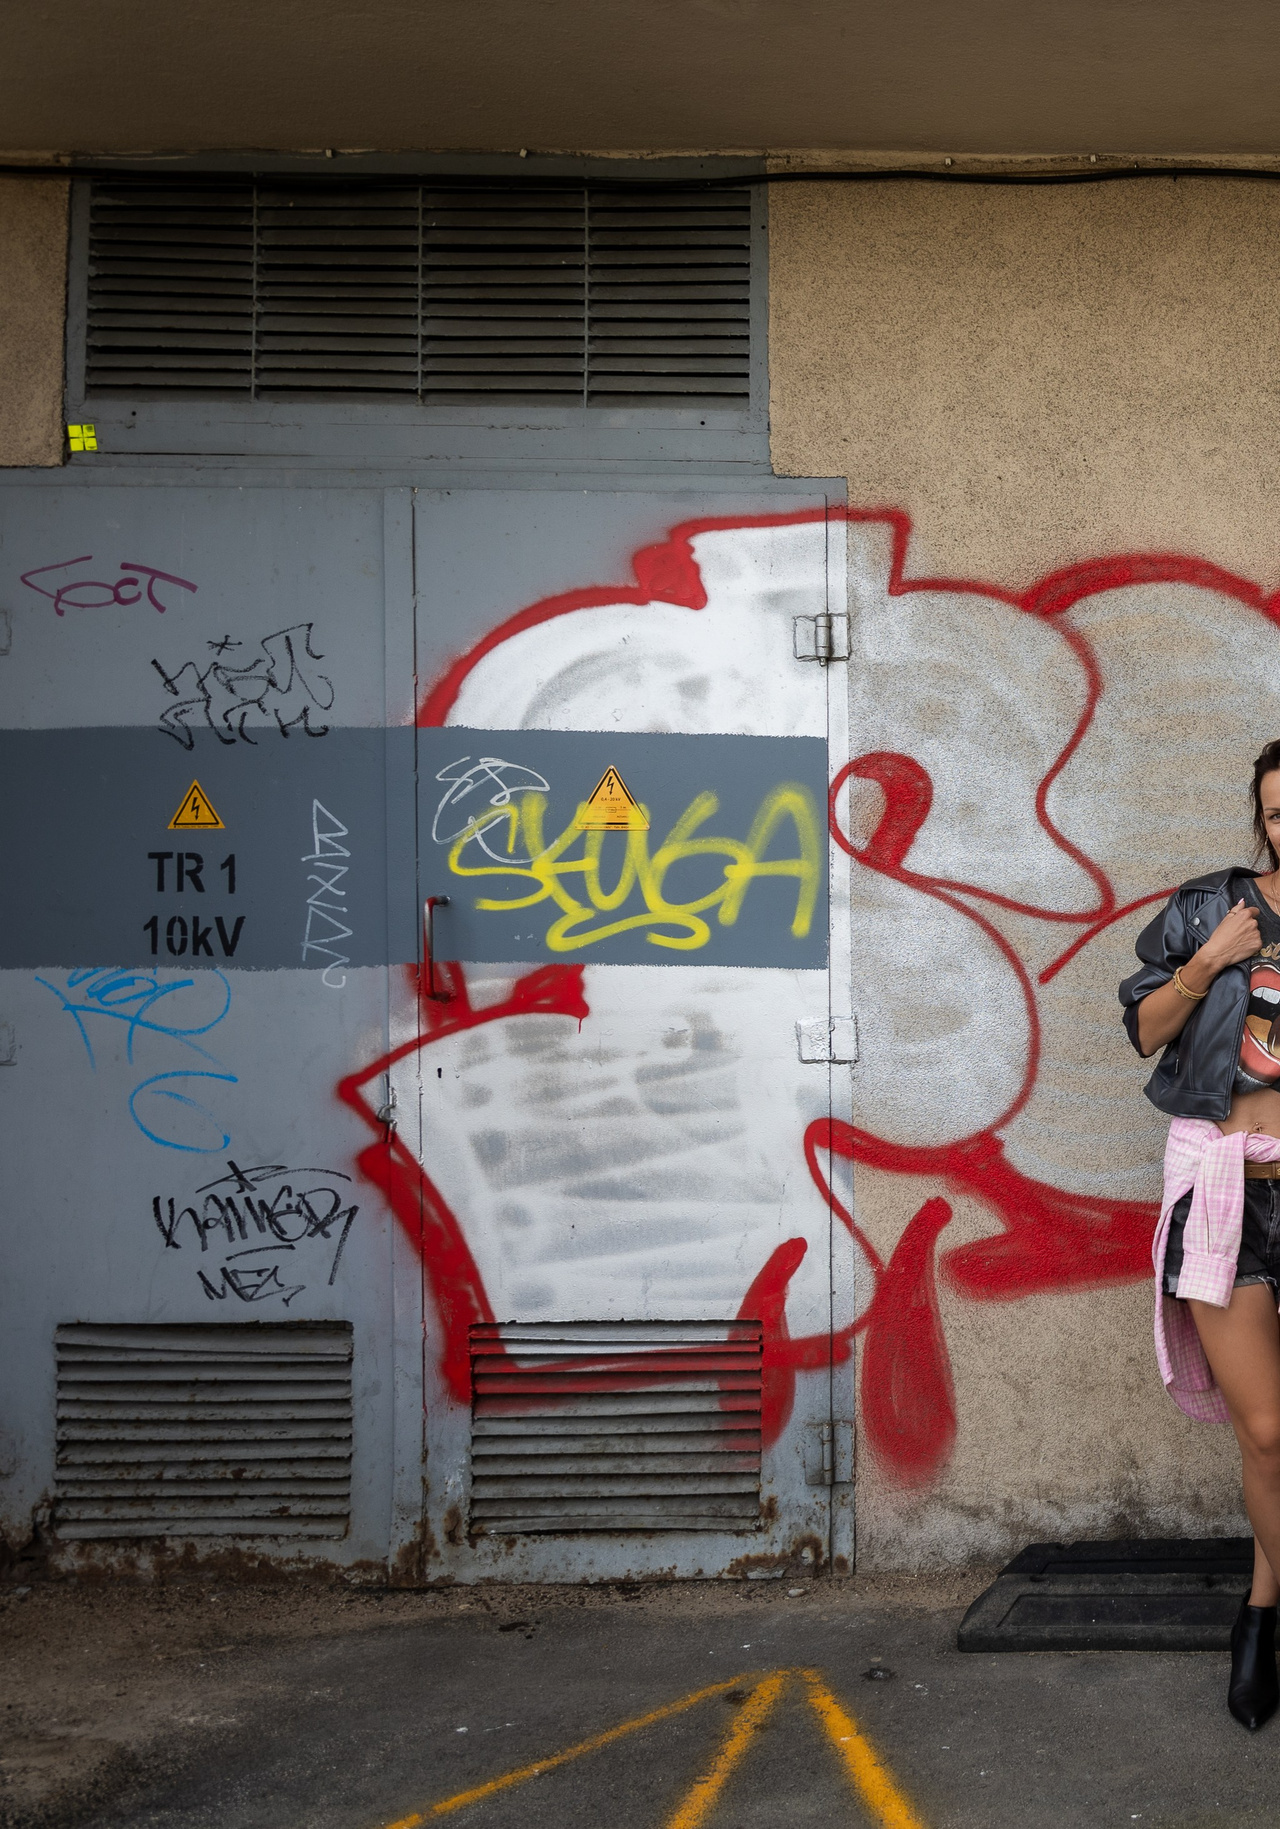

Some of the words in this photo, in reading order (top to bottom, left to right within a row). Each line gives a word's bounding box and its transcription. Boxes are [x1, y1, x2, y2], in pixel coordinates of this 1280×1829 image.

[148, 852, 206, 893] TR
[220, 853, 236, 894] 1
[143, 915, 246, 957] 10kV
